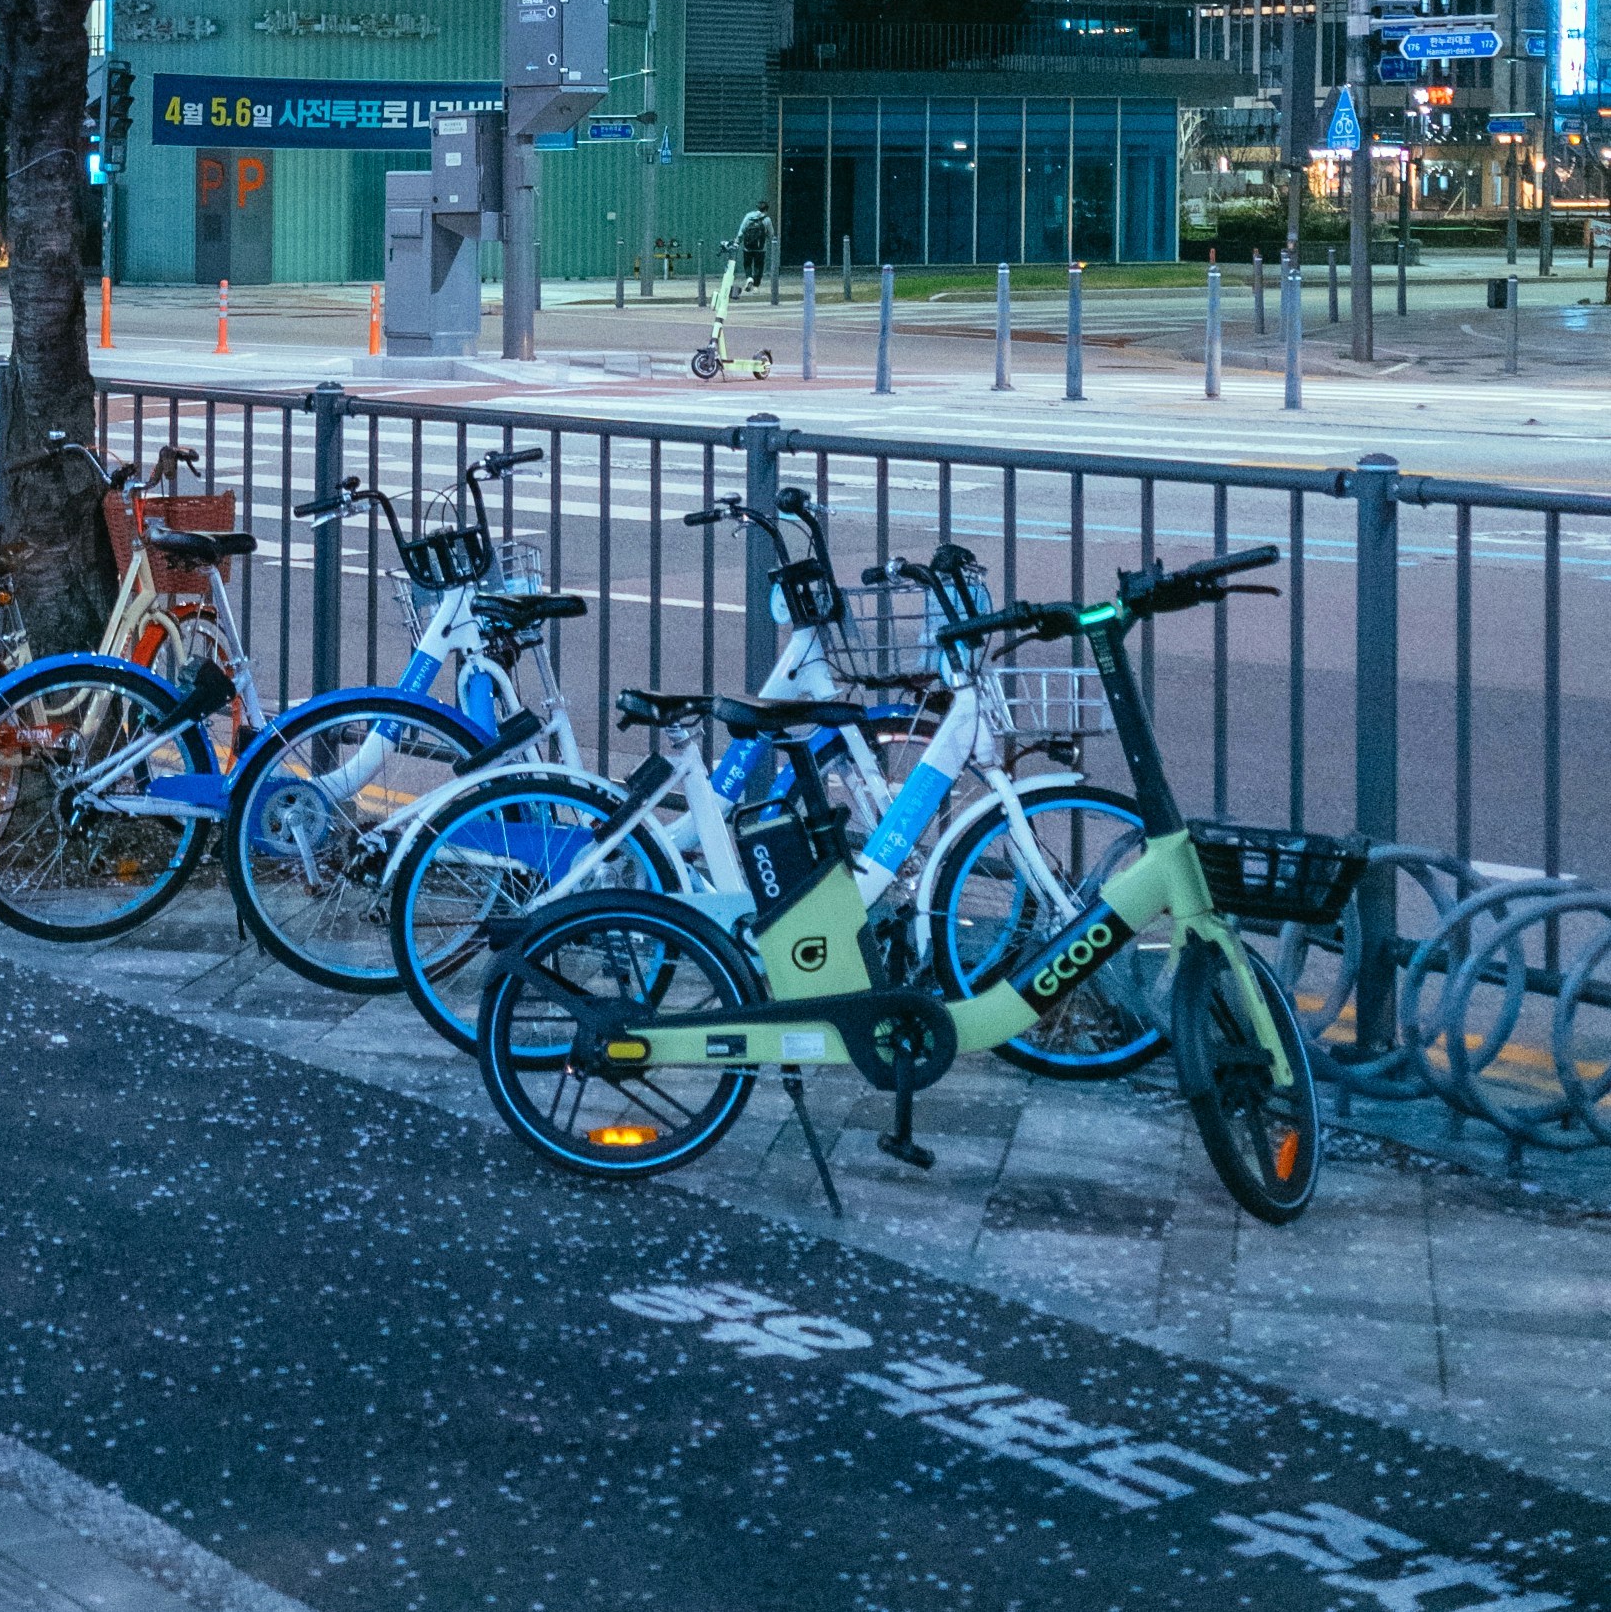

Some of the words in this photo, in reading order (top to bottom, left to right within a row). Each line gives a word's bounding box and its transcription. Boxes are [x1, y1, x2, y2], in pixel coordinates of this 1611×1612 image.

[1407, 43, 1420, 51] 176
[1429, 36, 1471, 47] 한누리대로
[1481, 39, 1494, 48] 172
[164, 96, 204, 127] 4월
[278, 98, 409, 129] 사전투표로
[237, 157, 266, 209] P
[753, 843, 781, 898] GCOO
[1033, 923, 1113, 997] GCOO
